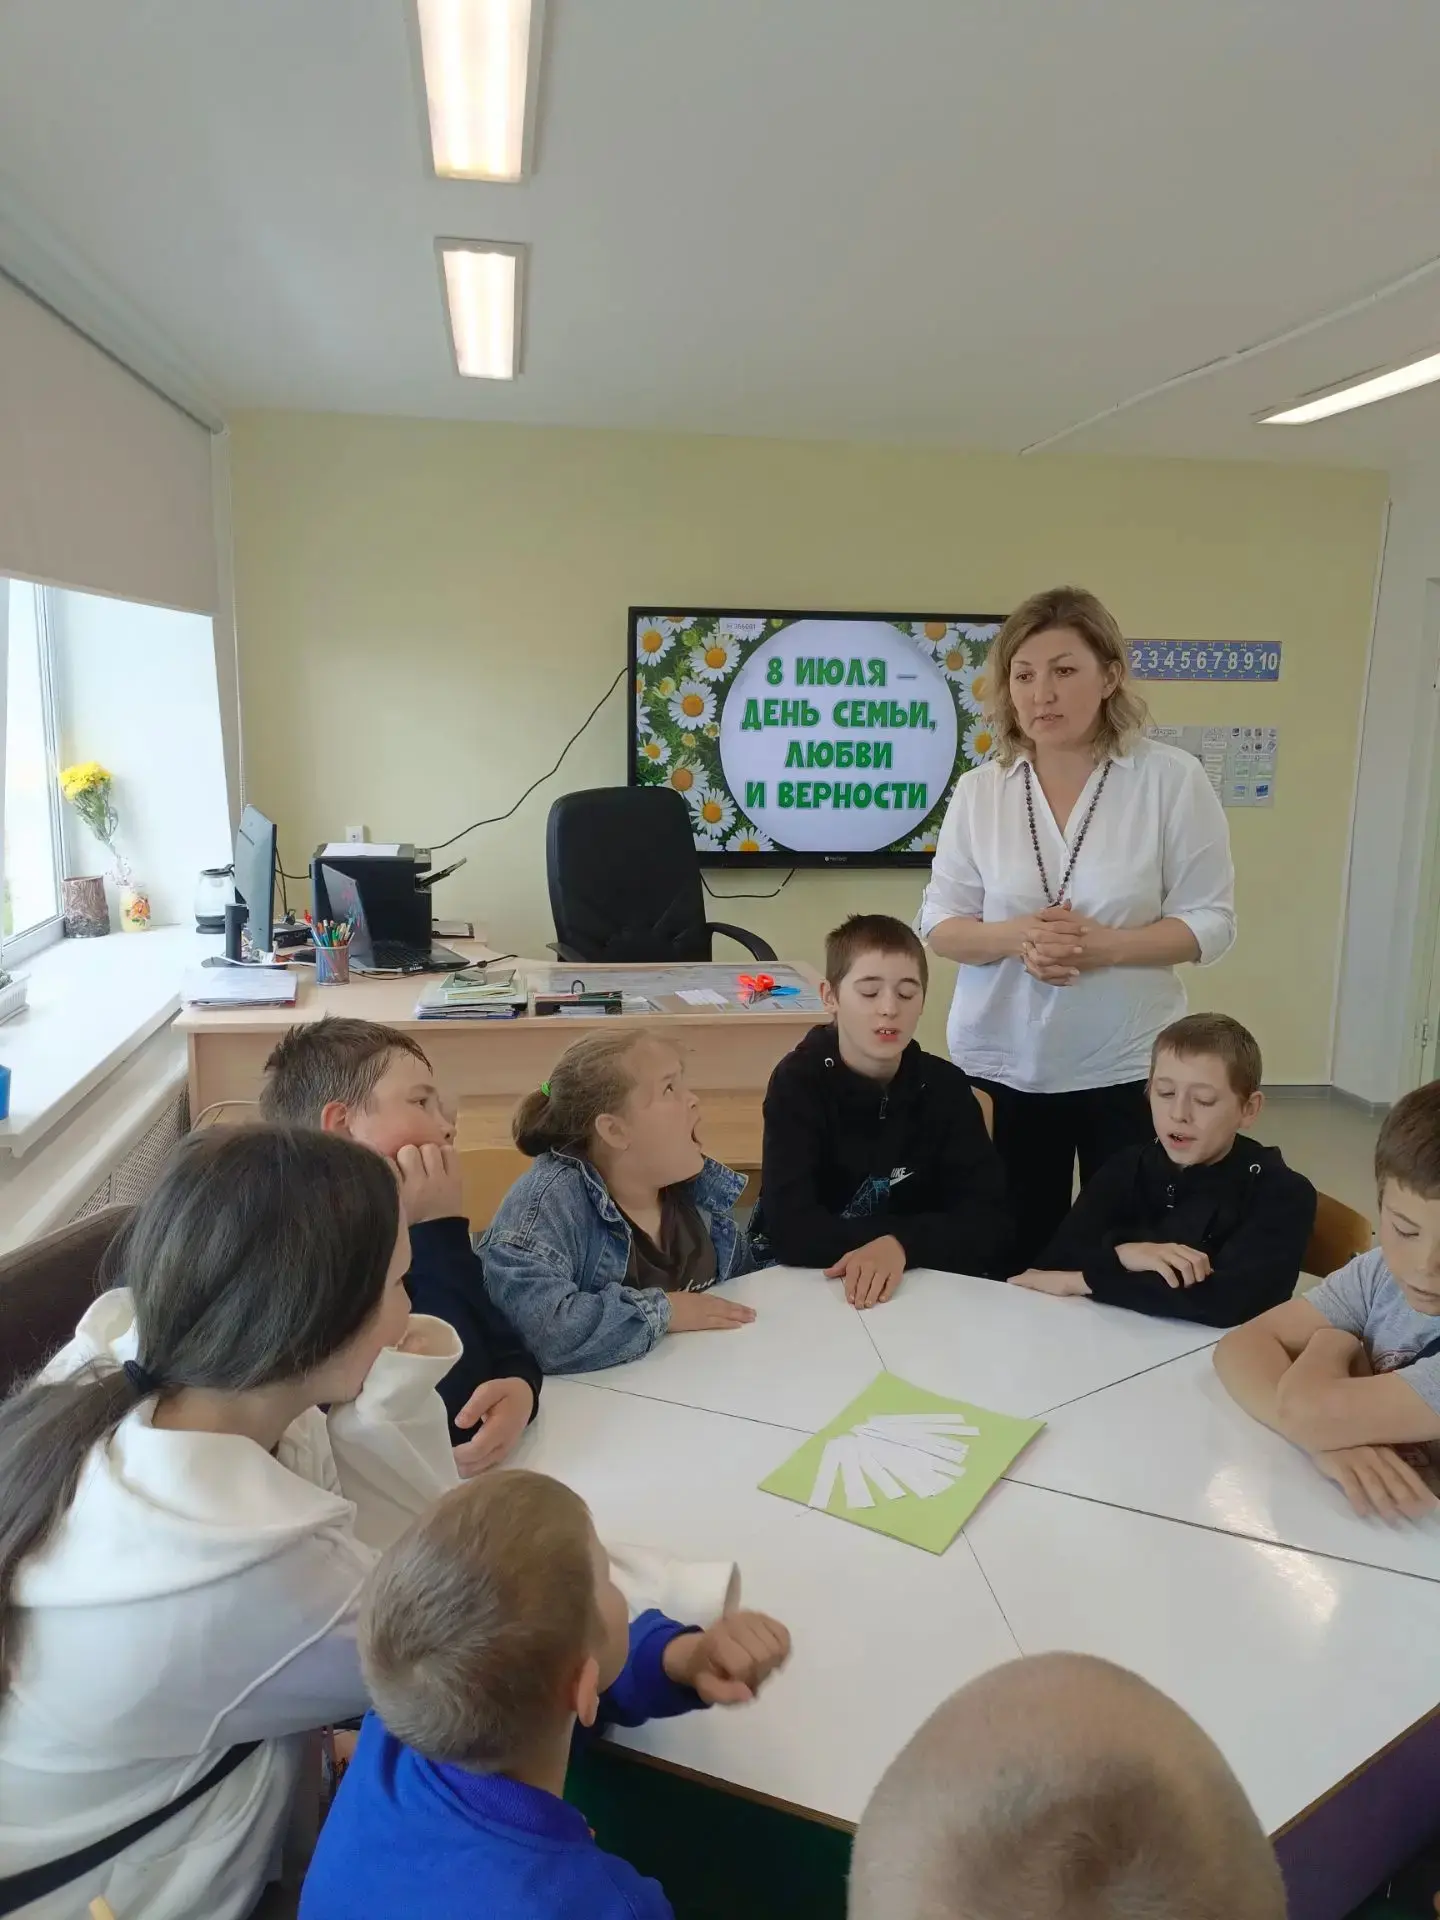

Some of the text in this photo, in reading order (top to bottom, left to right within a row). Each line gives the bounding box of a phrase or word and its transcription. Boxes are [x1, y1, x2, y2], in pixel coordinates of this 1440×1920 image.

[766, 657, 783, 685] 8
[796, 657, 886, 687] ИЮЛЯ
[1131, 650, 1278, 670] 2 3 4 5 6 7 8 9 10
[741, 699, 936, 733] ДЕНЬ СЕМЬИ,
[784, 740, 893, 769] ЛЮБВИ
[745, 781, 928, 809] И ВЕРНОСТИ
